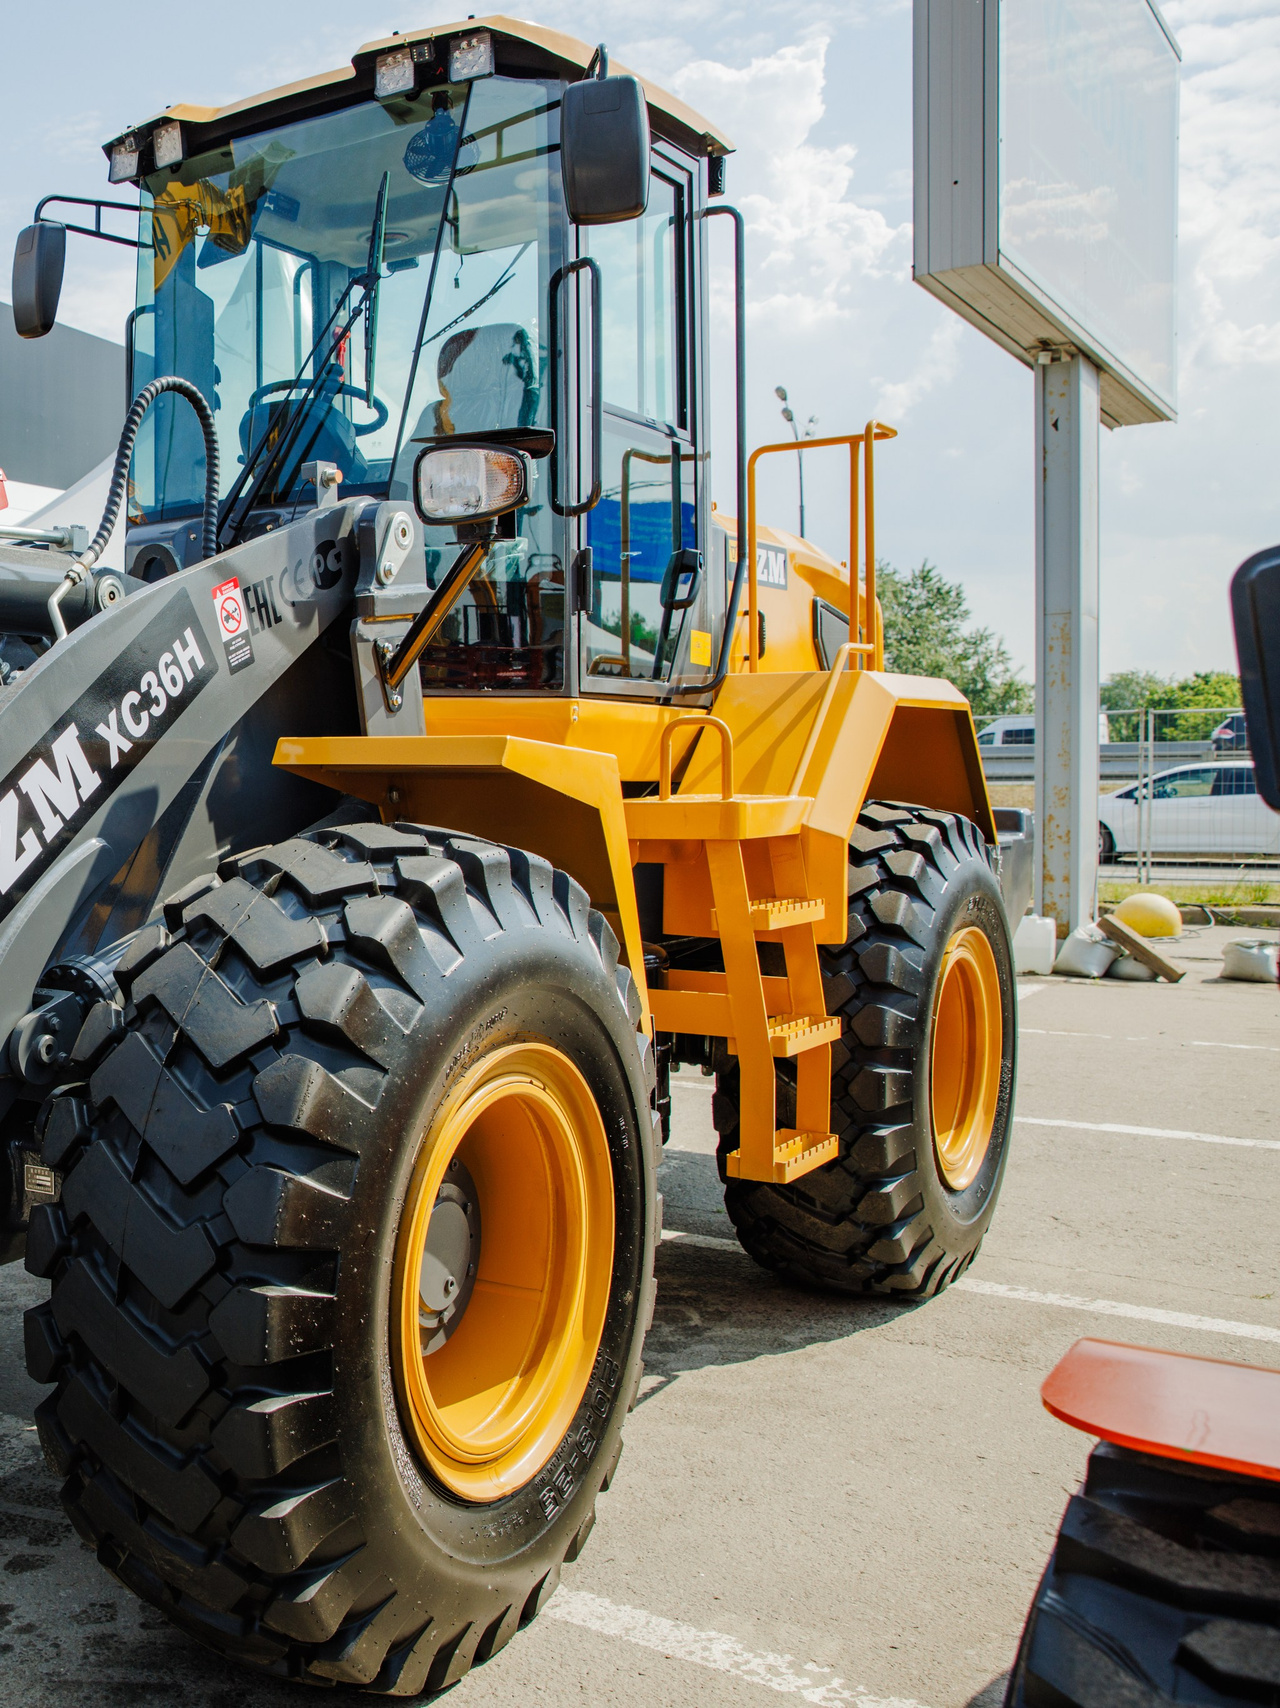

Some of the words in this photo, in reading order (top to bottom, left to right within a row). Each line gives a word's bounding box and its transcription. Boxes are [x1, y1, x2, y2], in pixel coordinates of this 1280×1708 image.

[743, 547, 786, 586] ZM
[94, 626, 207, 770] XC36H
[539, 1355, 620, 1522] 20.5-25
